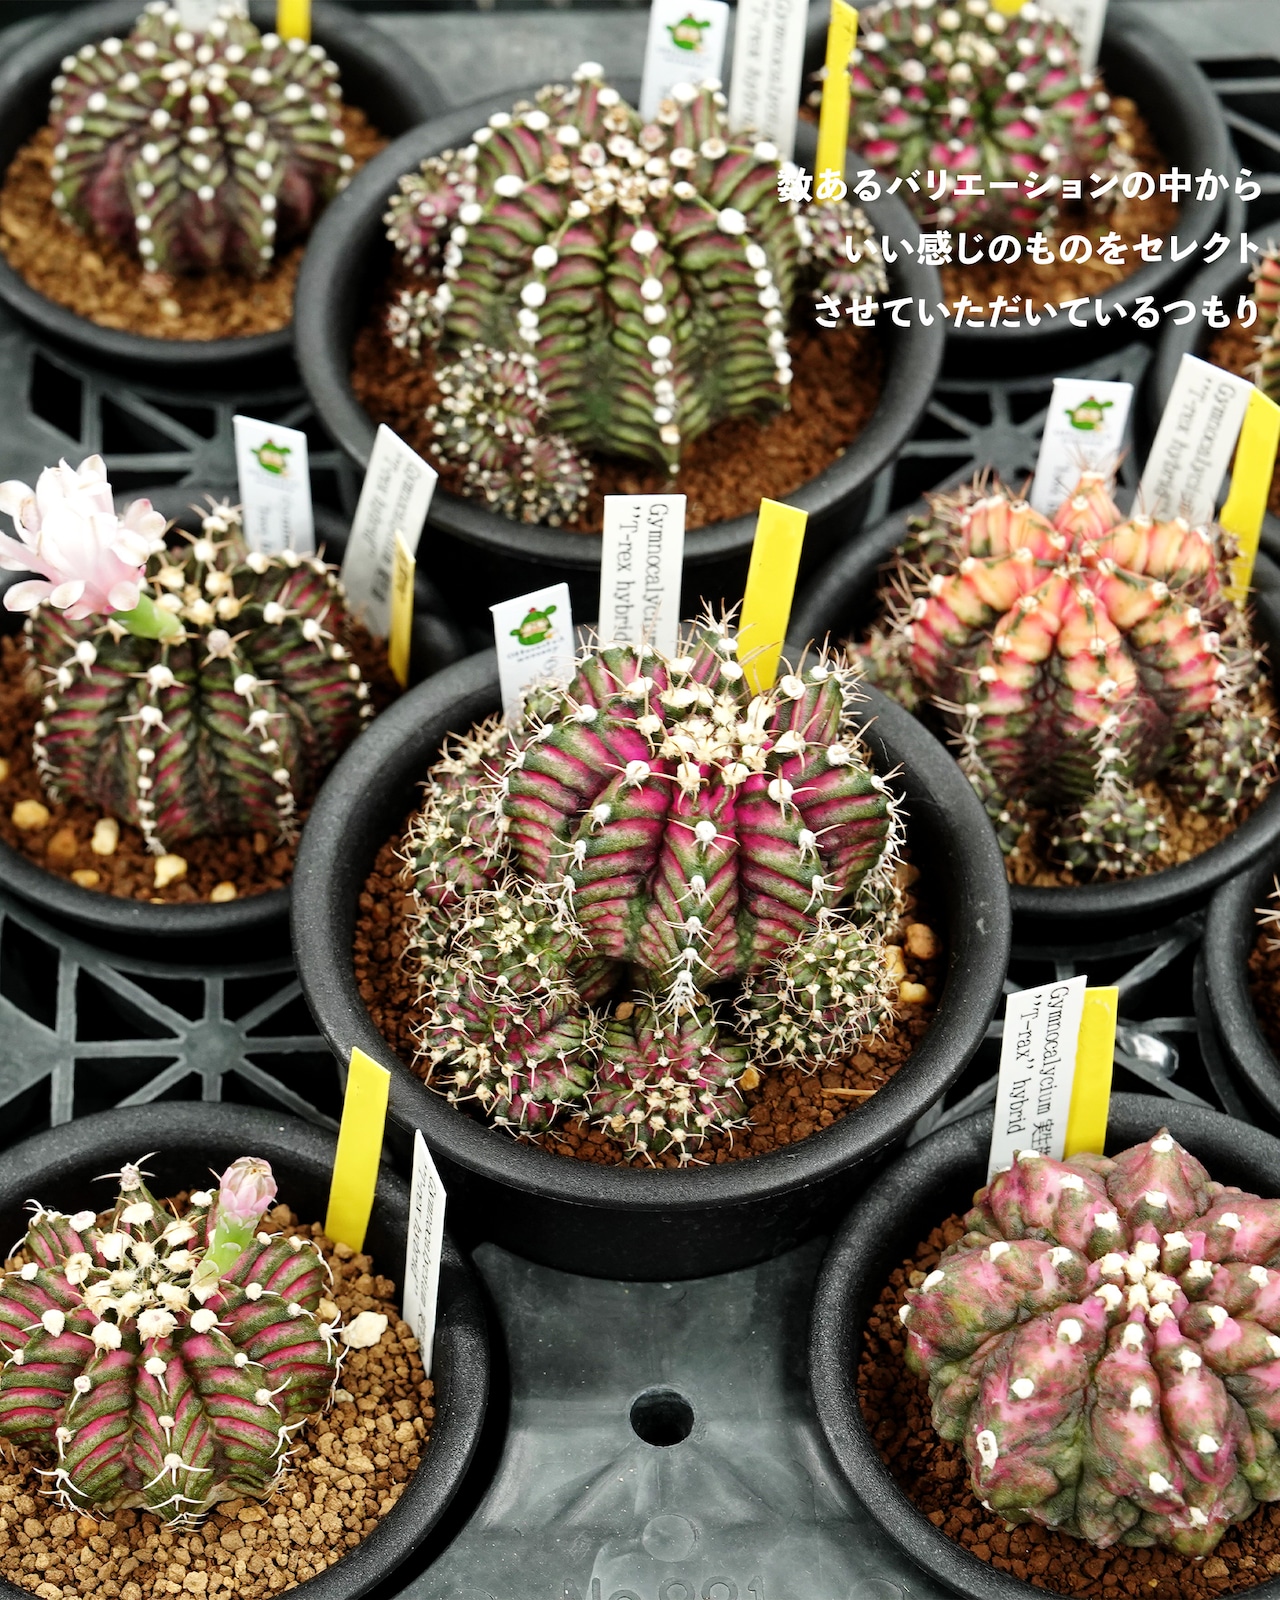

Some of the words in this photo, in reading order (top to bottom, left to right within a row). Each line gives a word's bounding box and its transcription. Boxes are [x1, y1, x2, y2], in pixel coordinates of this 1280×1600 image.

[613, 579, 636, 643] hybrid
[1037, 986, 1070, 1115] Gymnocalycium
[1006, 1078, 1032, 1136] hybrid
